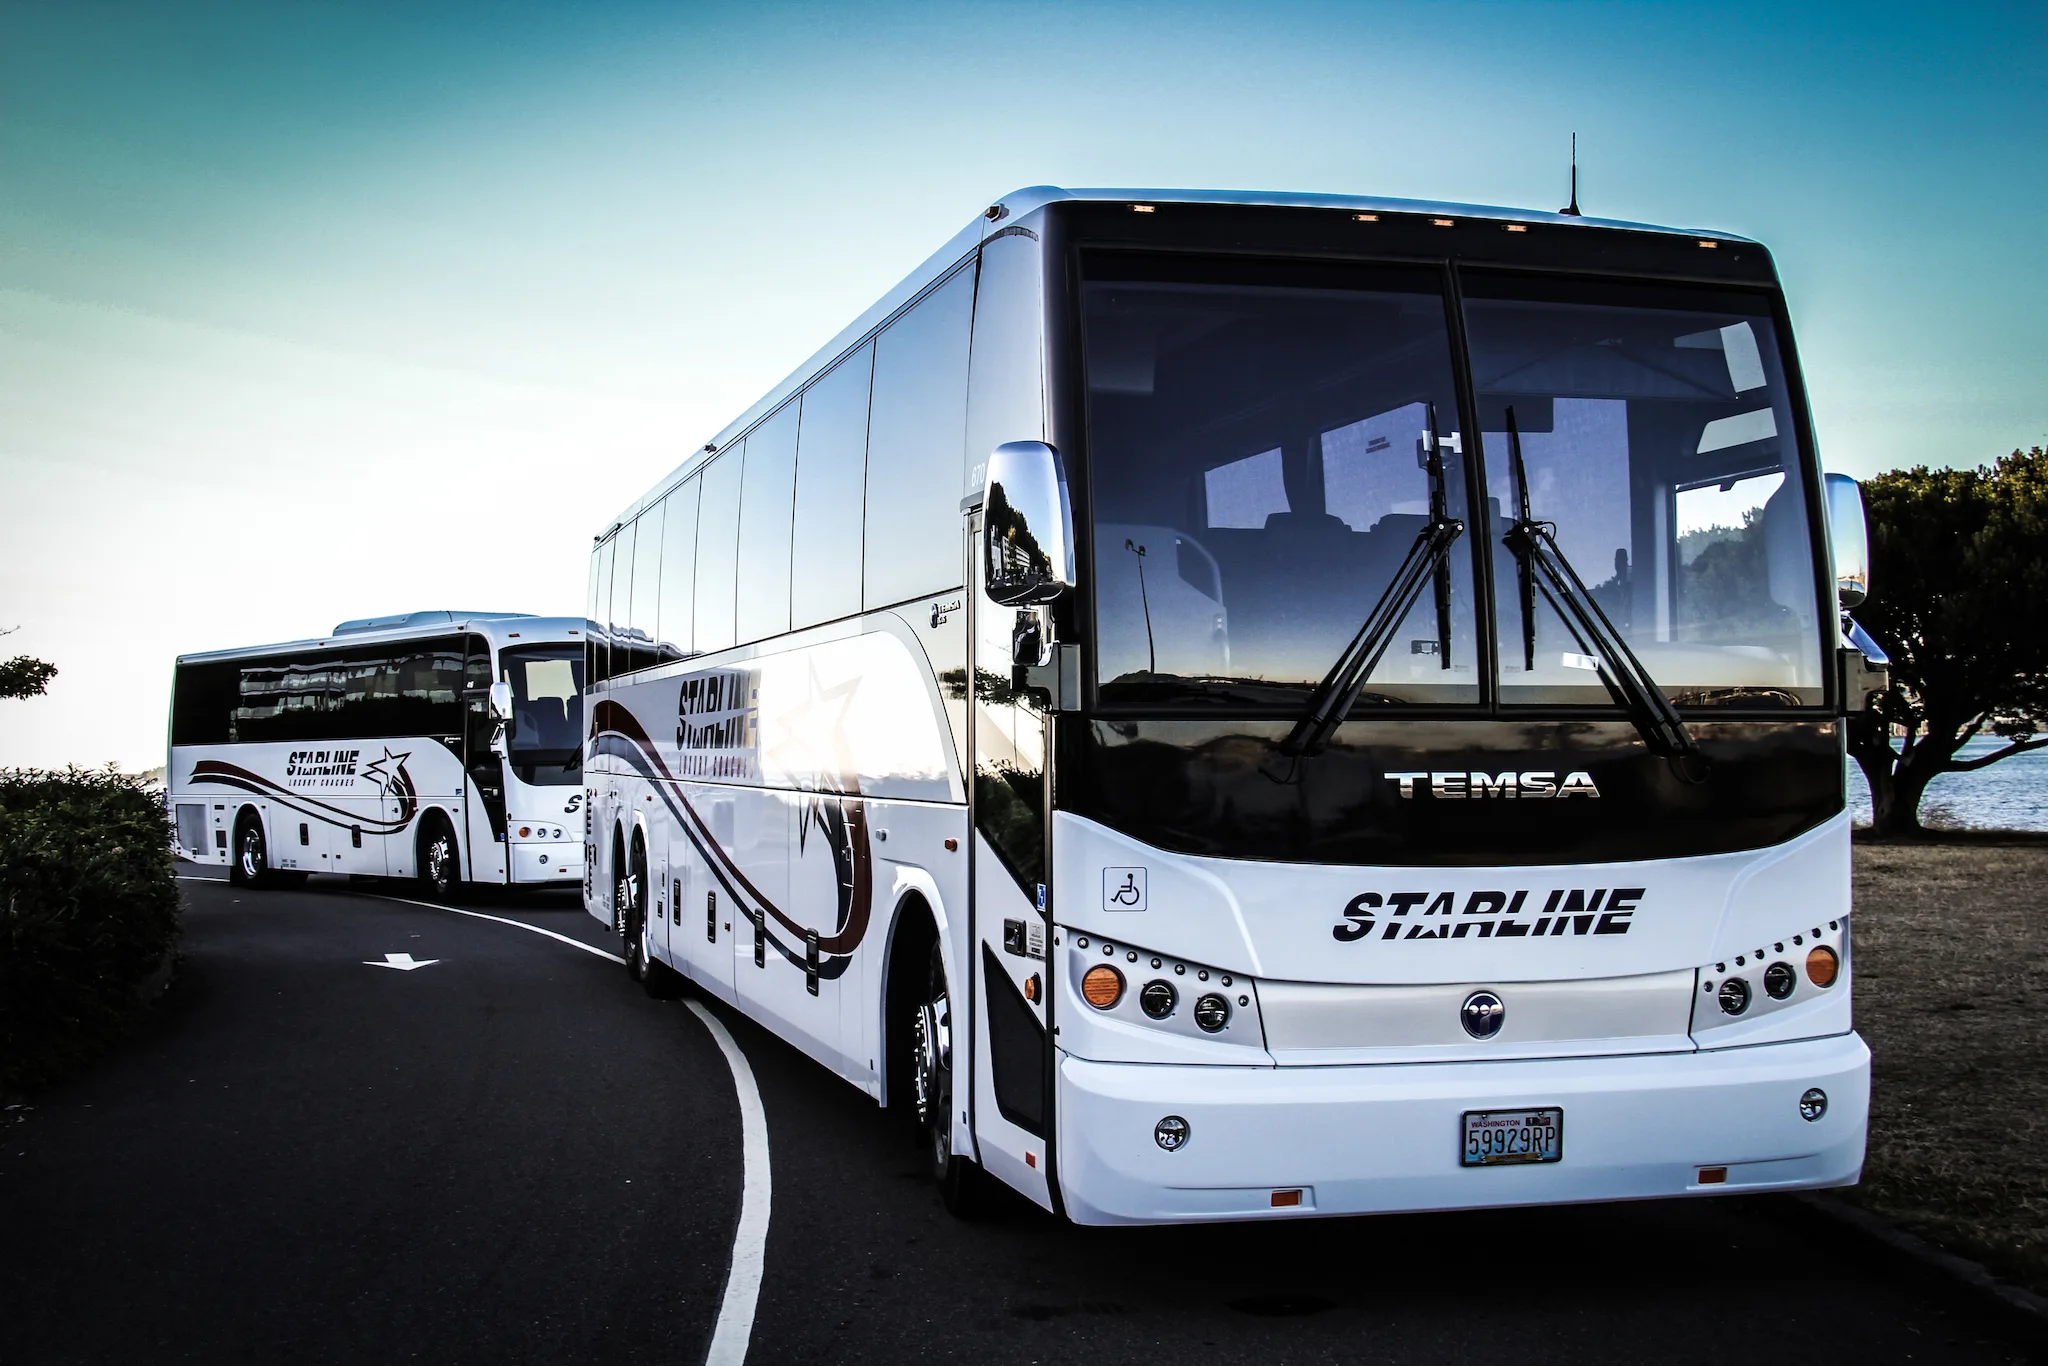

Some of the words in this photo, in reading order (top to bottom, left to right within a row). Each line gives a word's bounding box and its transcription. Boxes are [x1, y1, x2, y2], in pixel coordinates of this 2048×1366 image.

[971, 462, 986, 488] 670
[937, 599, 961, 614] TEMSA
[286, 749, 361, 777] STARLINE
[1384, 770, 1601, 799] TEMSA
[1332, 887, 1647, 943] STARLINE
[1471, 1119, 1521, 1129] WASHINGTON
[1468, 1126, 1556, 1156] 59929RP
